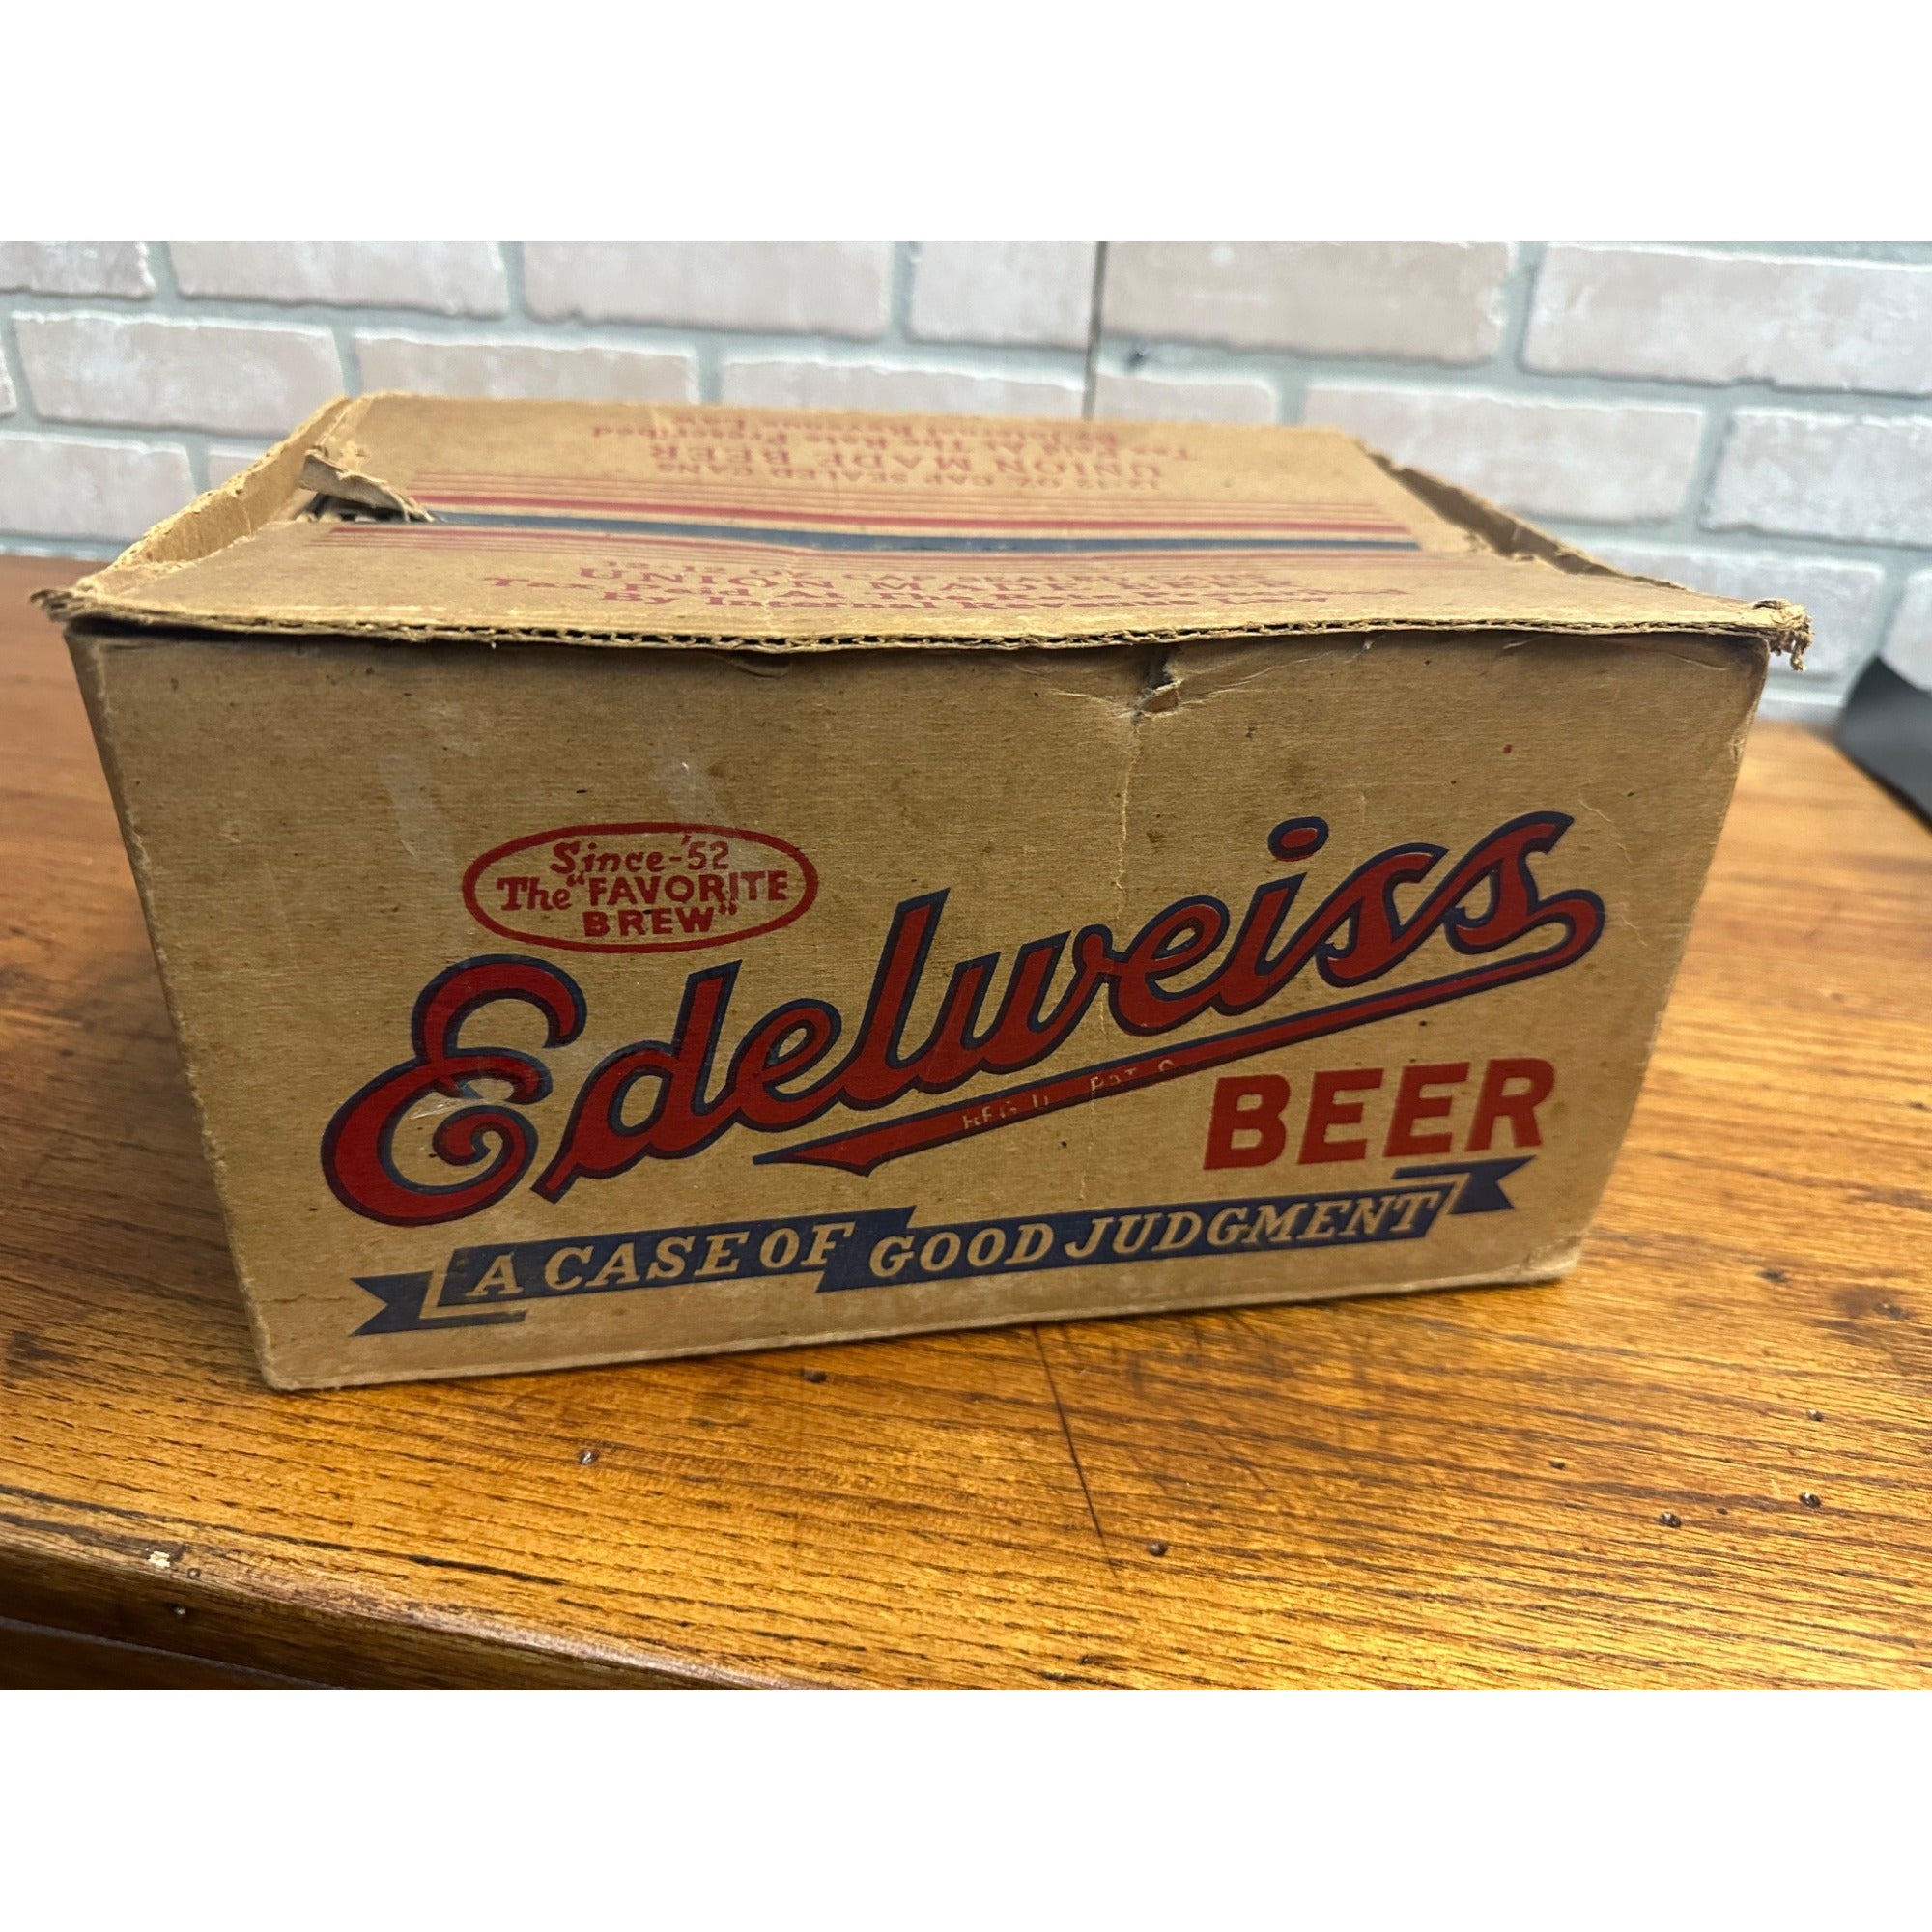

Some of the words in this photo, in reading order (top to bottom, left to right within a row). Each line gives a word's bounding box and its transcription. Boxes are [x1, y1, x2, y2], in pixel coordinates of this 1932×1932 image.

[649, 445, 790, 466] BEER
[816, 452, 972, 471] MADE
[657, 463, 753, 477] CANS
[768, 468, 908, 485] SEALED
[994, 458, 1162, 478] UNION
[923, 474, 994, 487] CAP
[579, 566, 836, 590] UNION
[867, 580, 1093, 592] MADE
[1115, 580, 1306, 590] BEER
[841, 573, 937, 582] CAP
[483, 576, 605, 590] Tax
[623, 582, 753, 597] Paid
[776, 589, 847, 600] At
[864, 591, 975, 602] The
[993, 592, 1122, 602] Rate
[1134, 588, 1410, 599] Prescribed
[599, 591, 681, 605] By
[704, 596, 938, 610] Internal
[958, 599, 1201, 610] Revenue
[497, 876, 572, 911] The
[320, 811, 1606, 1225] Edelweiss
[1204, 1058, 1556, 1170] BEER
[464, 1252, 523, 1297] A
[544, 1231, 750, 1291] CASE
[759, 1221, 855, 1269] OF
[869, 1223, 1055, 1278] GOOD
[1064, 1190, 1446, 1258] JUDGMENT
